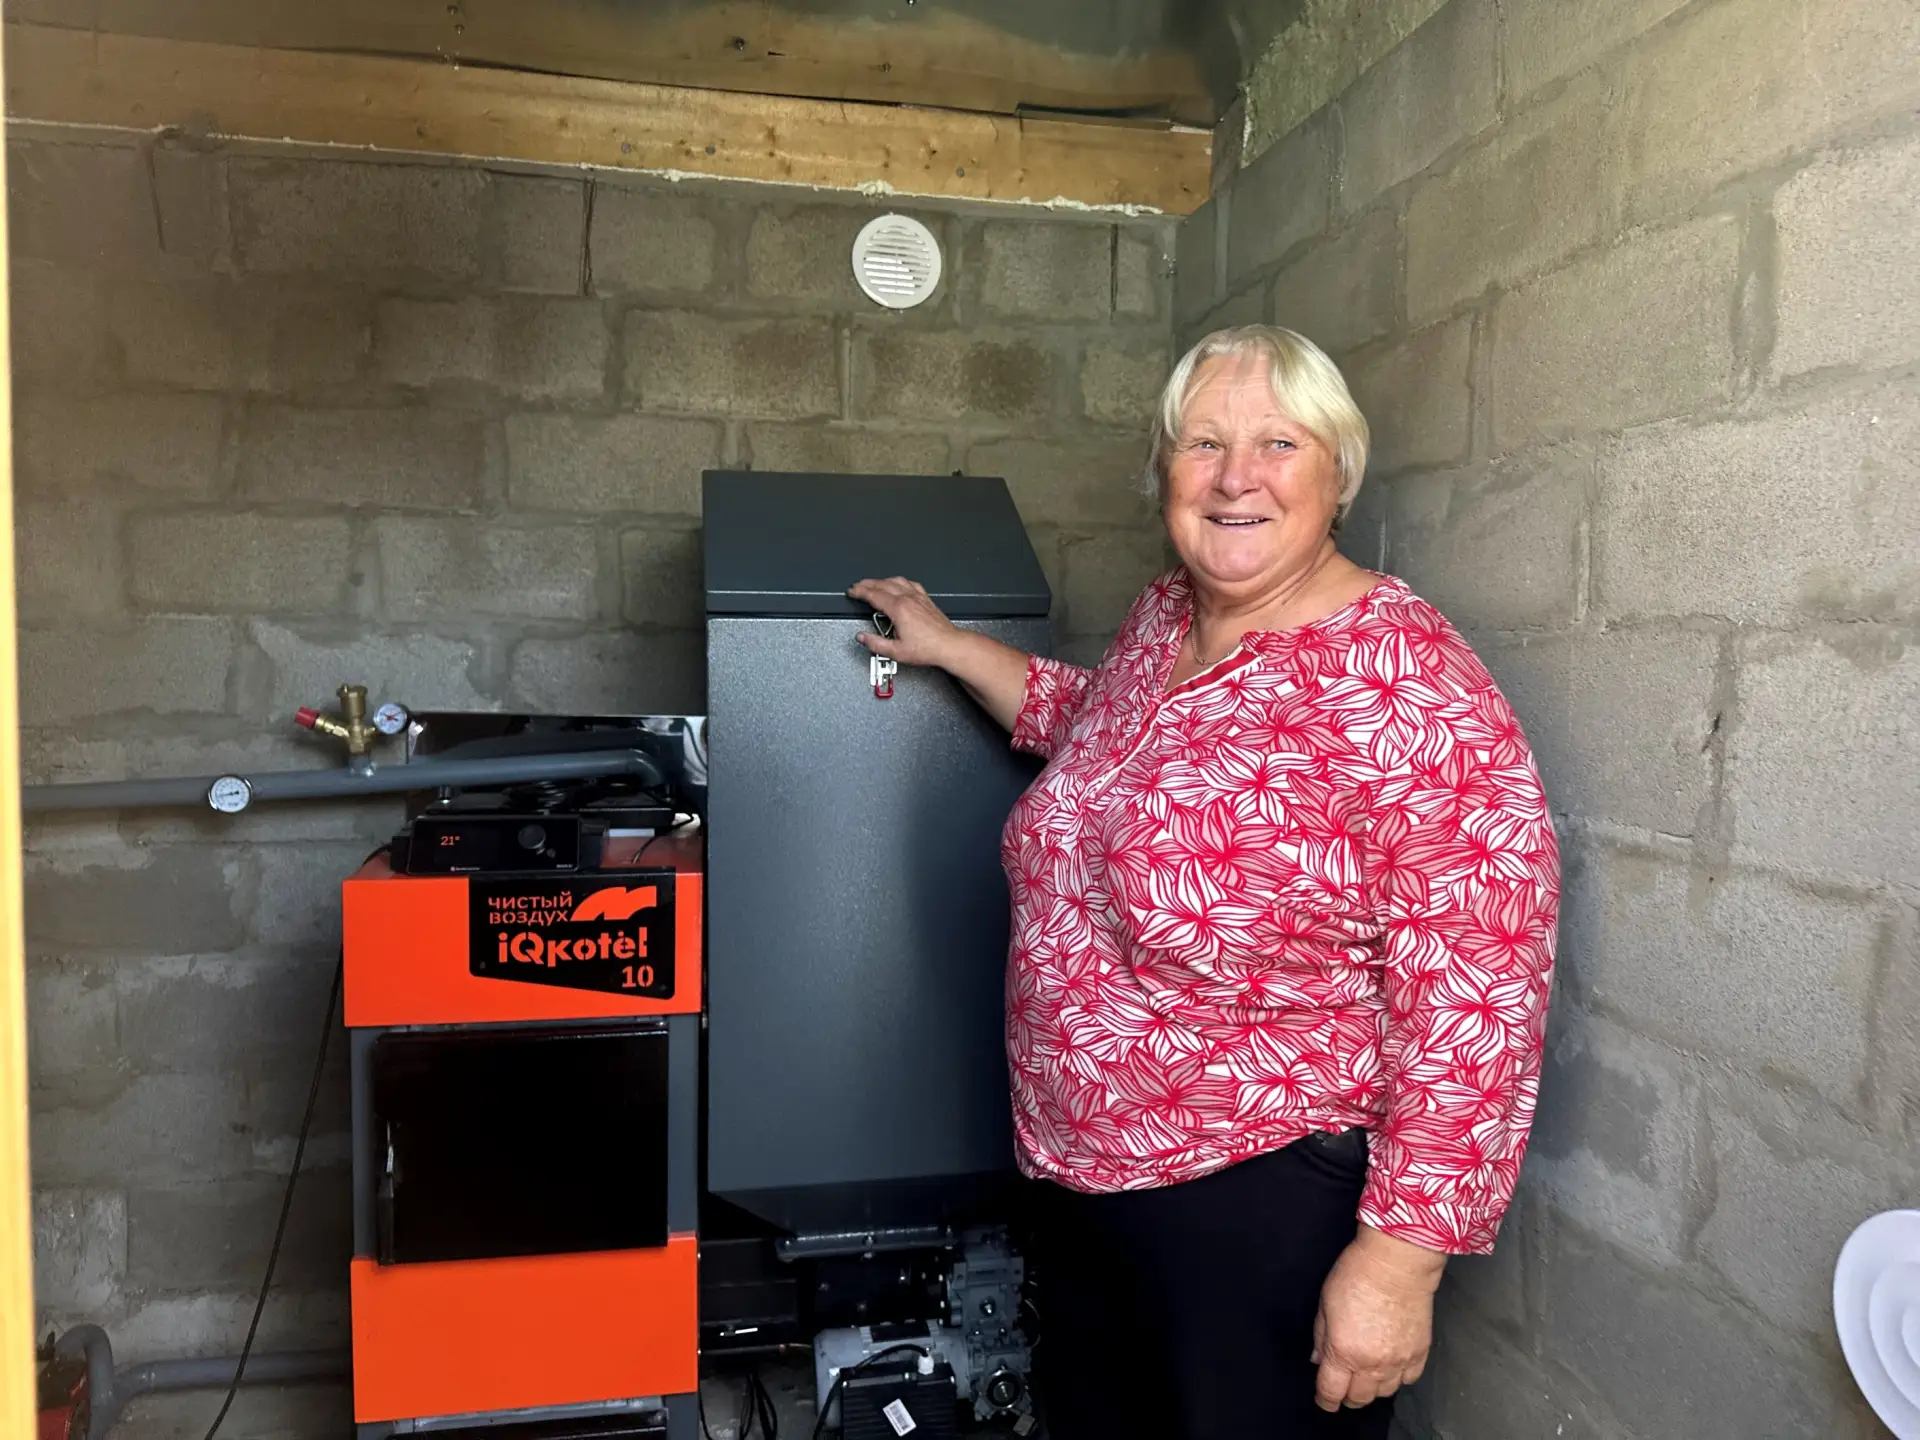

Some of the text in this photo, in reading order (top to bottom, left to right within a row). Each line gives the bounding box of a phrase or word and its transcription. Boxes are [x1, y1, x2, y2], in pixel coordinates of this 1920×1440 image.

[440, 835, 460, 846] 21°
[488, 891, 572, 909] ЧИСТЫЙ
[489, 910, 568, 926] ВОЗДУХ
[621, 965, 654, 988] 10
